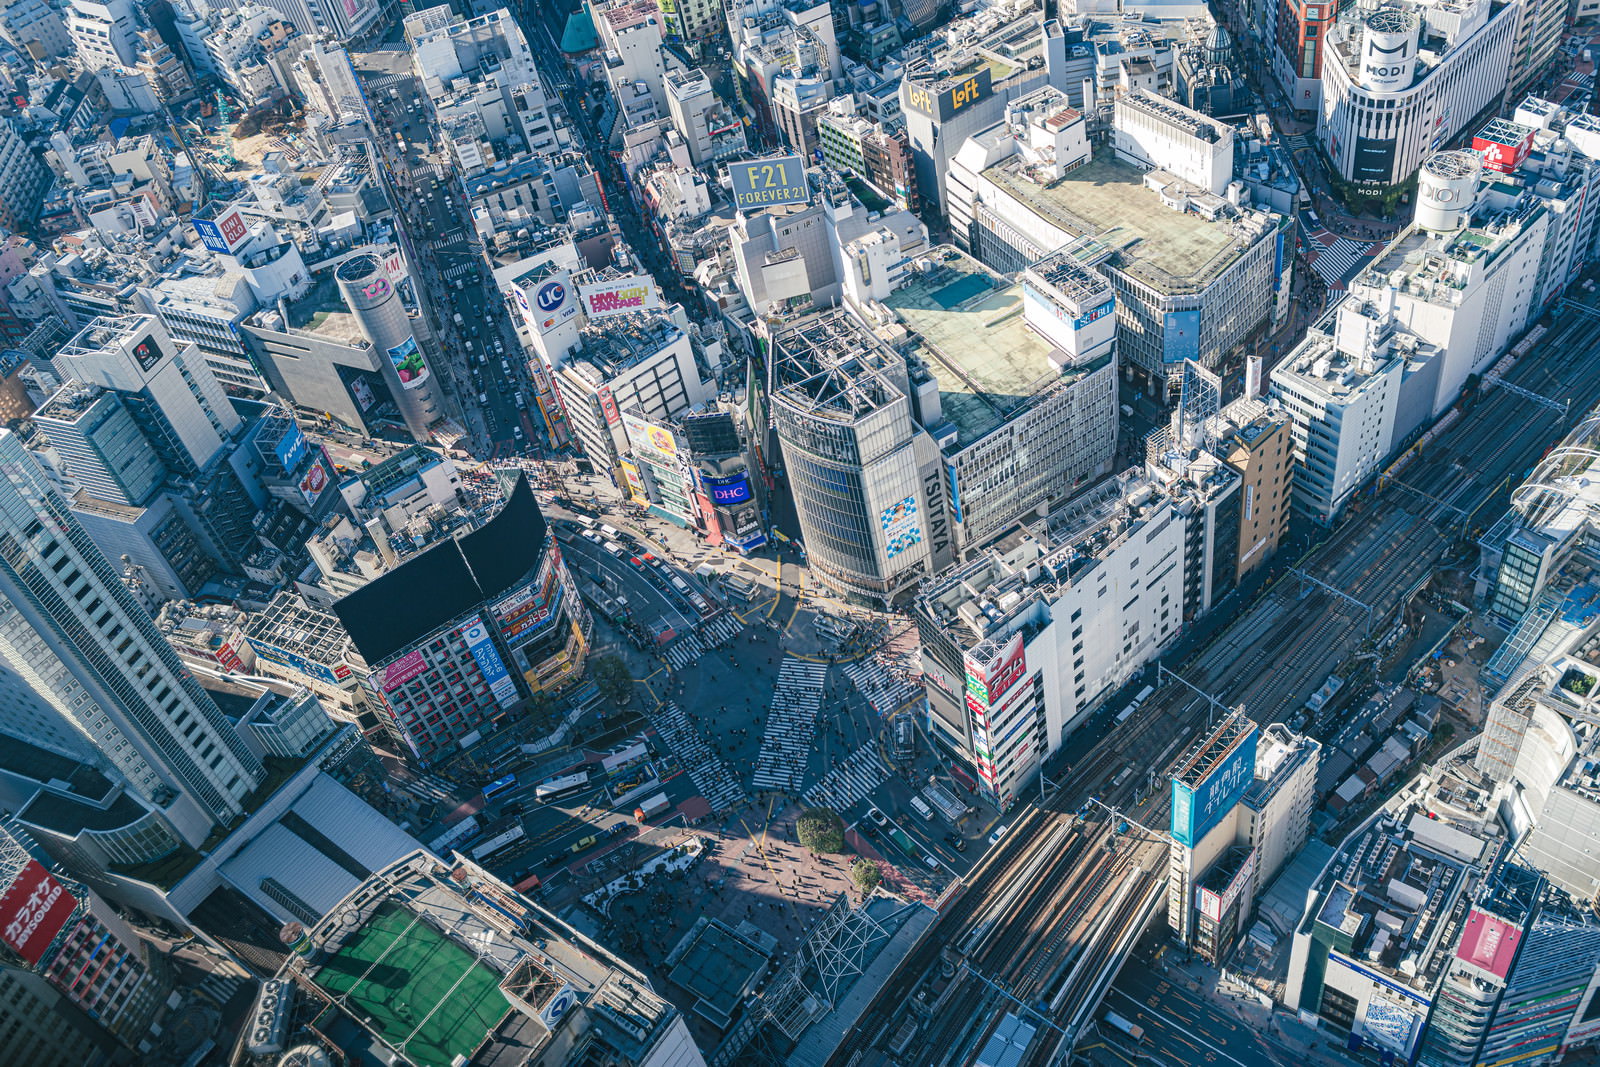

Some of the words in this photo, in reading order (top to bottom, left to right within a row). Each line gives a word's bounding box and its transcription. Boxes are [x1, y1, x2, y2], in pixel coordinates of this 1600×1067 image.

[1366, 63, 1405, 77] MODI
[747, 163, 788, 190] F21
[738, 188, 791, 205] FOREVER
[792, 186, 805, 198] 21
[1357, 188, 1383, 196] MODI
[199, 223, 216, 237] THE
[223, 217, 239, 232] UNI
[228, 224, 244, 241] QLO
[201, 235, 227, 250] PRIME
[362, 278, 391, 300] 109
[538, 284, 564, 308] UC
[589, 290, 619, 305] HMV
[562, 308, 576, 318] VISA
[714, 487, 744, 499] DHC
[925, 469, 948, 554] TSUTAYA
[990, 656, 1023, 692] アコム
[1204, 767, 1247, 814] ダイレクト
[5, 876, 50, 941] カラオケ
[15, 886, 62, 949] JOYSOUND
